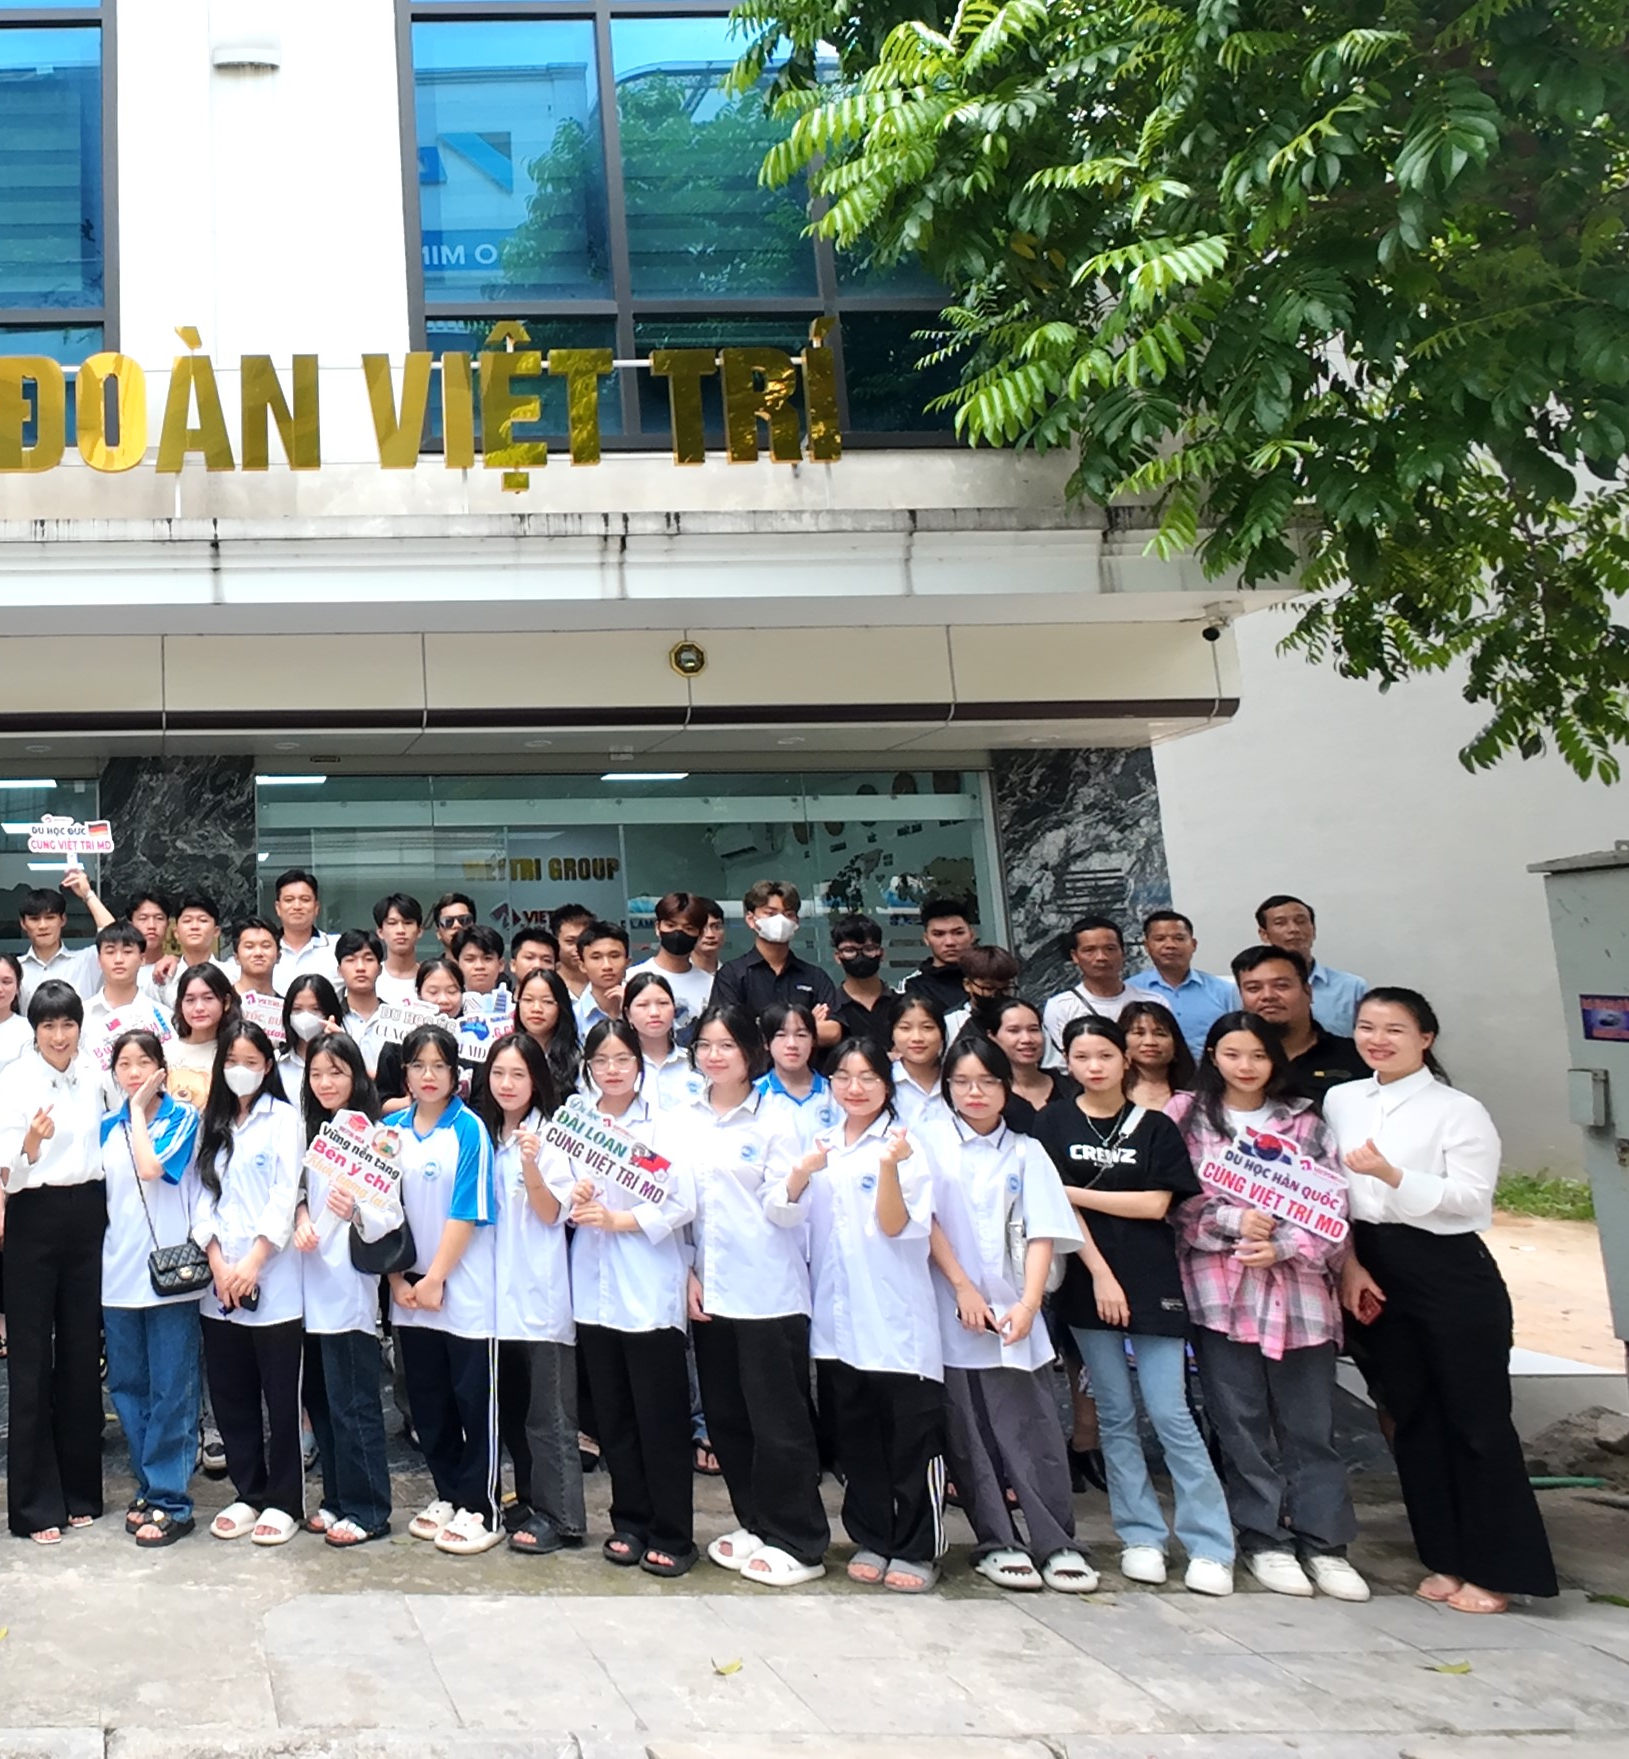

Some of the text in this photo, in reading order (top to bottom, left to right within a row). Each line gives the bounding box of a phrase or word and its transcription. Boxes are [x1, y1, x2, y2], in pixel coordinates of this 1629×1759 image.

[361, 320, 613, 493] VIỆT
[649, 315, 843, 467] TRÍ
[97, 840, 112, 850] MD
[548, 857, 620, 881] GROUP
[556, 1110, 585, 1134] ĐÀI
[584, 1126, 628, 1158] LOAN
[1069, 1144, 1137, 1165] CREWZ
[545, 1127, 585, 1158] CÙNG
[585, 1148, 617, 1176] VIỆT
[616, 1166, 641, 1191] TRÍ
[639, 1180, 665, 1204] MD
[1224, 1150, 1243, 1165] DU
[1244, 1160, 1272, 1180] HỌC
[1272, 1172, 1300, 1192] HÀN
[1302, 1187, 1339, 1211] QUỐC
[1203, 1162, 1345, 1238] CÙNG VIỆT TRÍ MD
